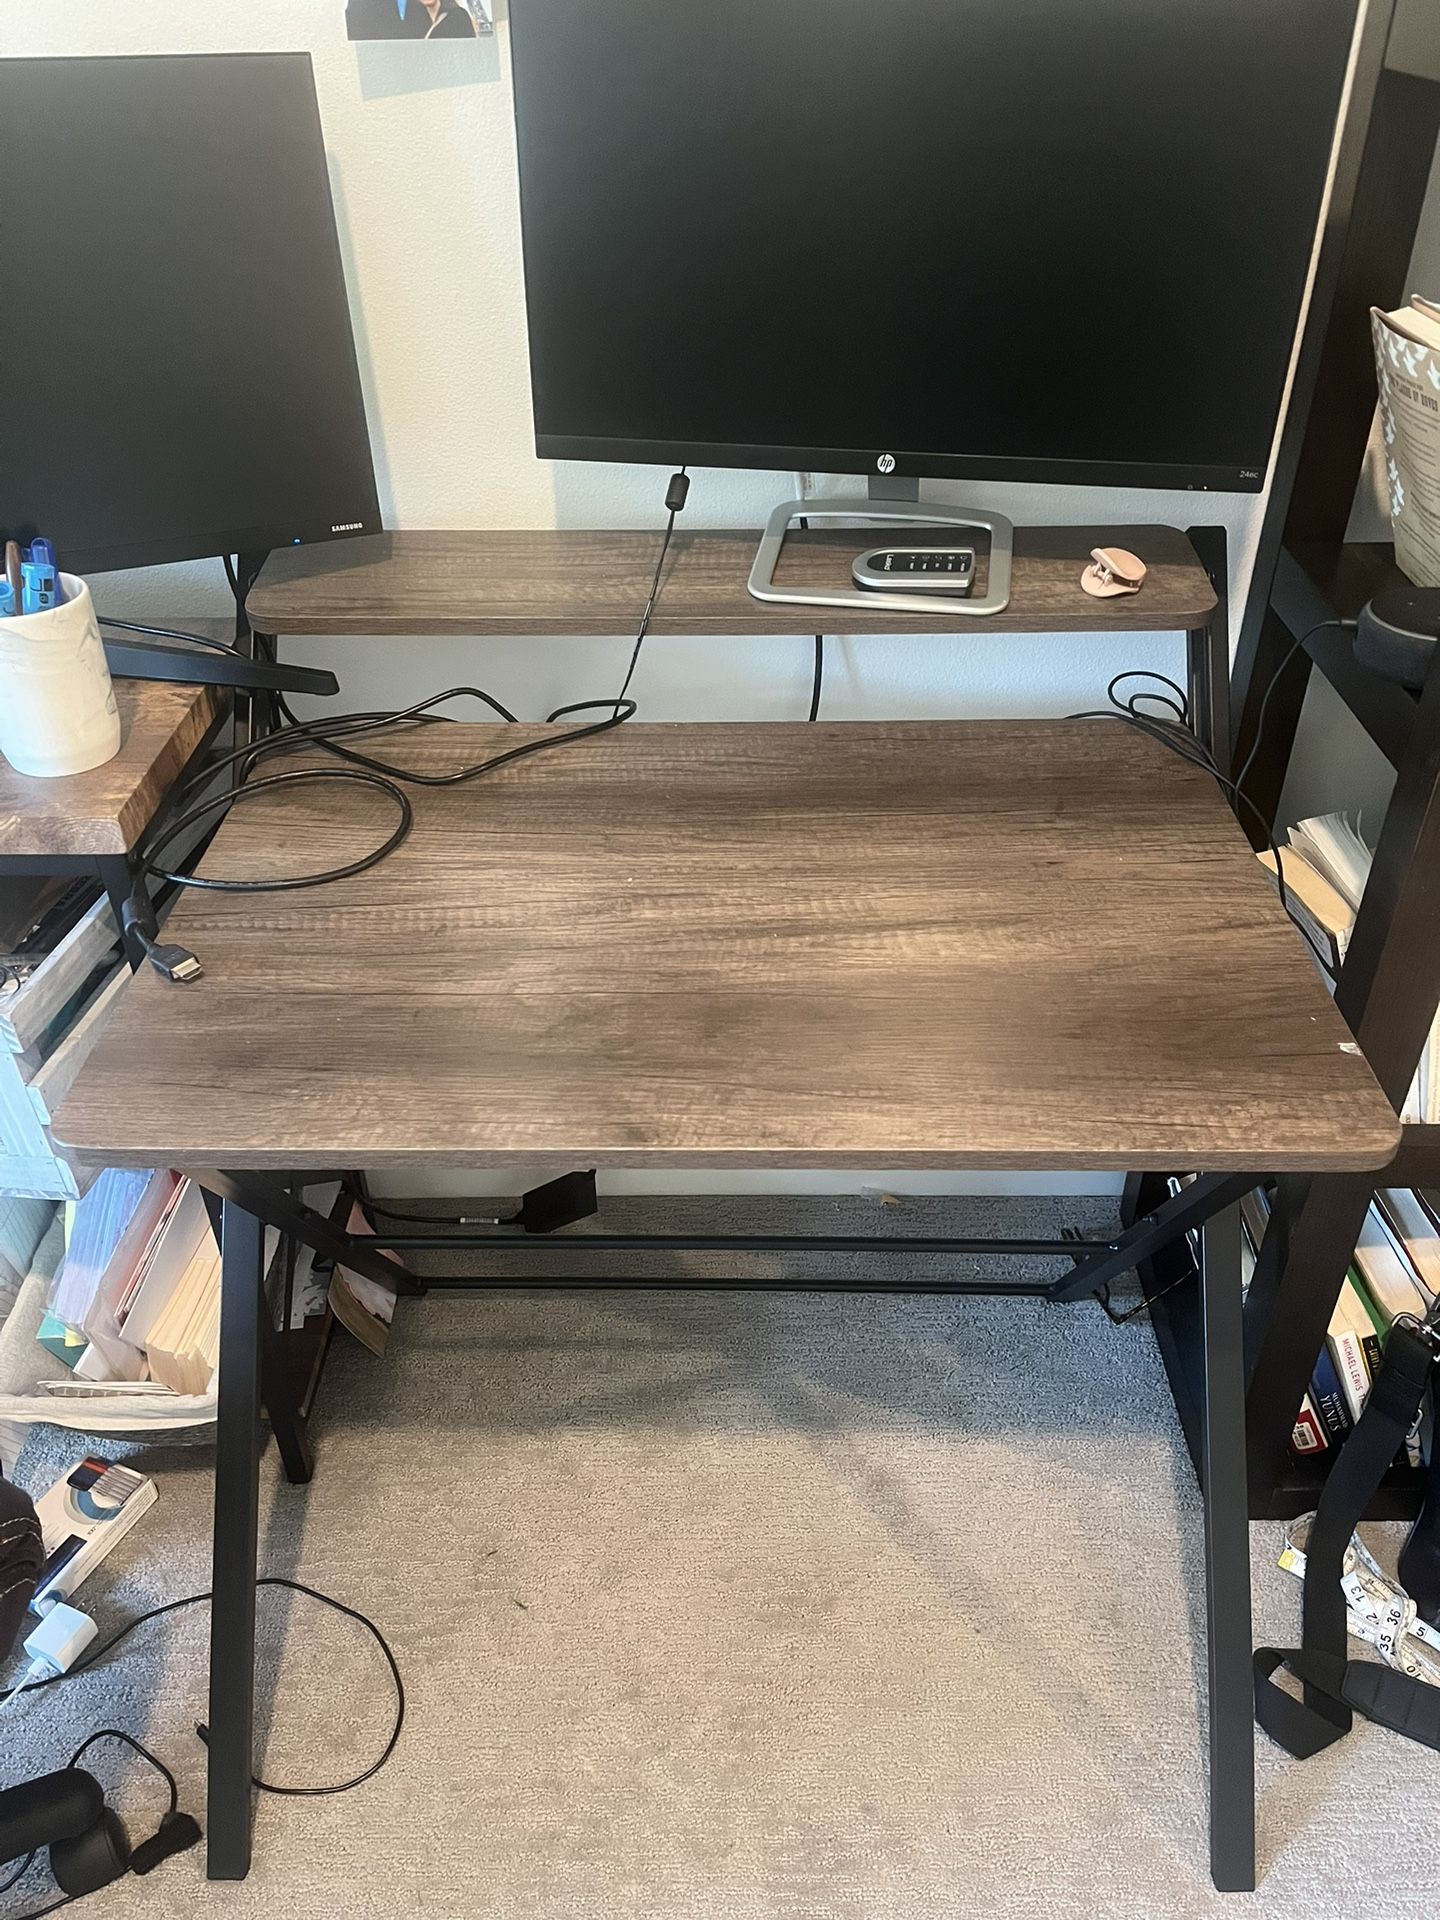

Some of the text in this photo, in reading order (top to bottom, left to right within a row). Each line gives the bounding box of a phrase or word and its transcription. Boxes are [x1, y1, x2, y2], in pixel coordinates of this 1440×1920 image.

[878, 454, 896, 473] hp
[1239, 470, 1259, 479] 24ec
[331, 522, 363, 532] SAMSUNG
[1342, 1338, 1357, 1370] MICHAEL
[1350, 1370, 1364, 1392] LEWIS
[1320, 1395, 1341, 1431] YUNUS
[1332, 1392, 1349, 1428] MUHAMMAD
[1350, 1585, 1366, 1603] 13
[1379, 1608, 1401, 1652] 35 36
[1416, 1626, 1426, 1637] 5
